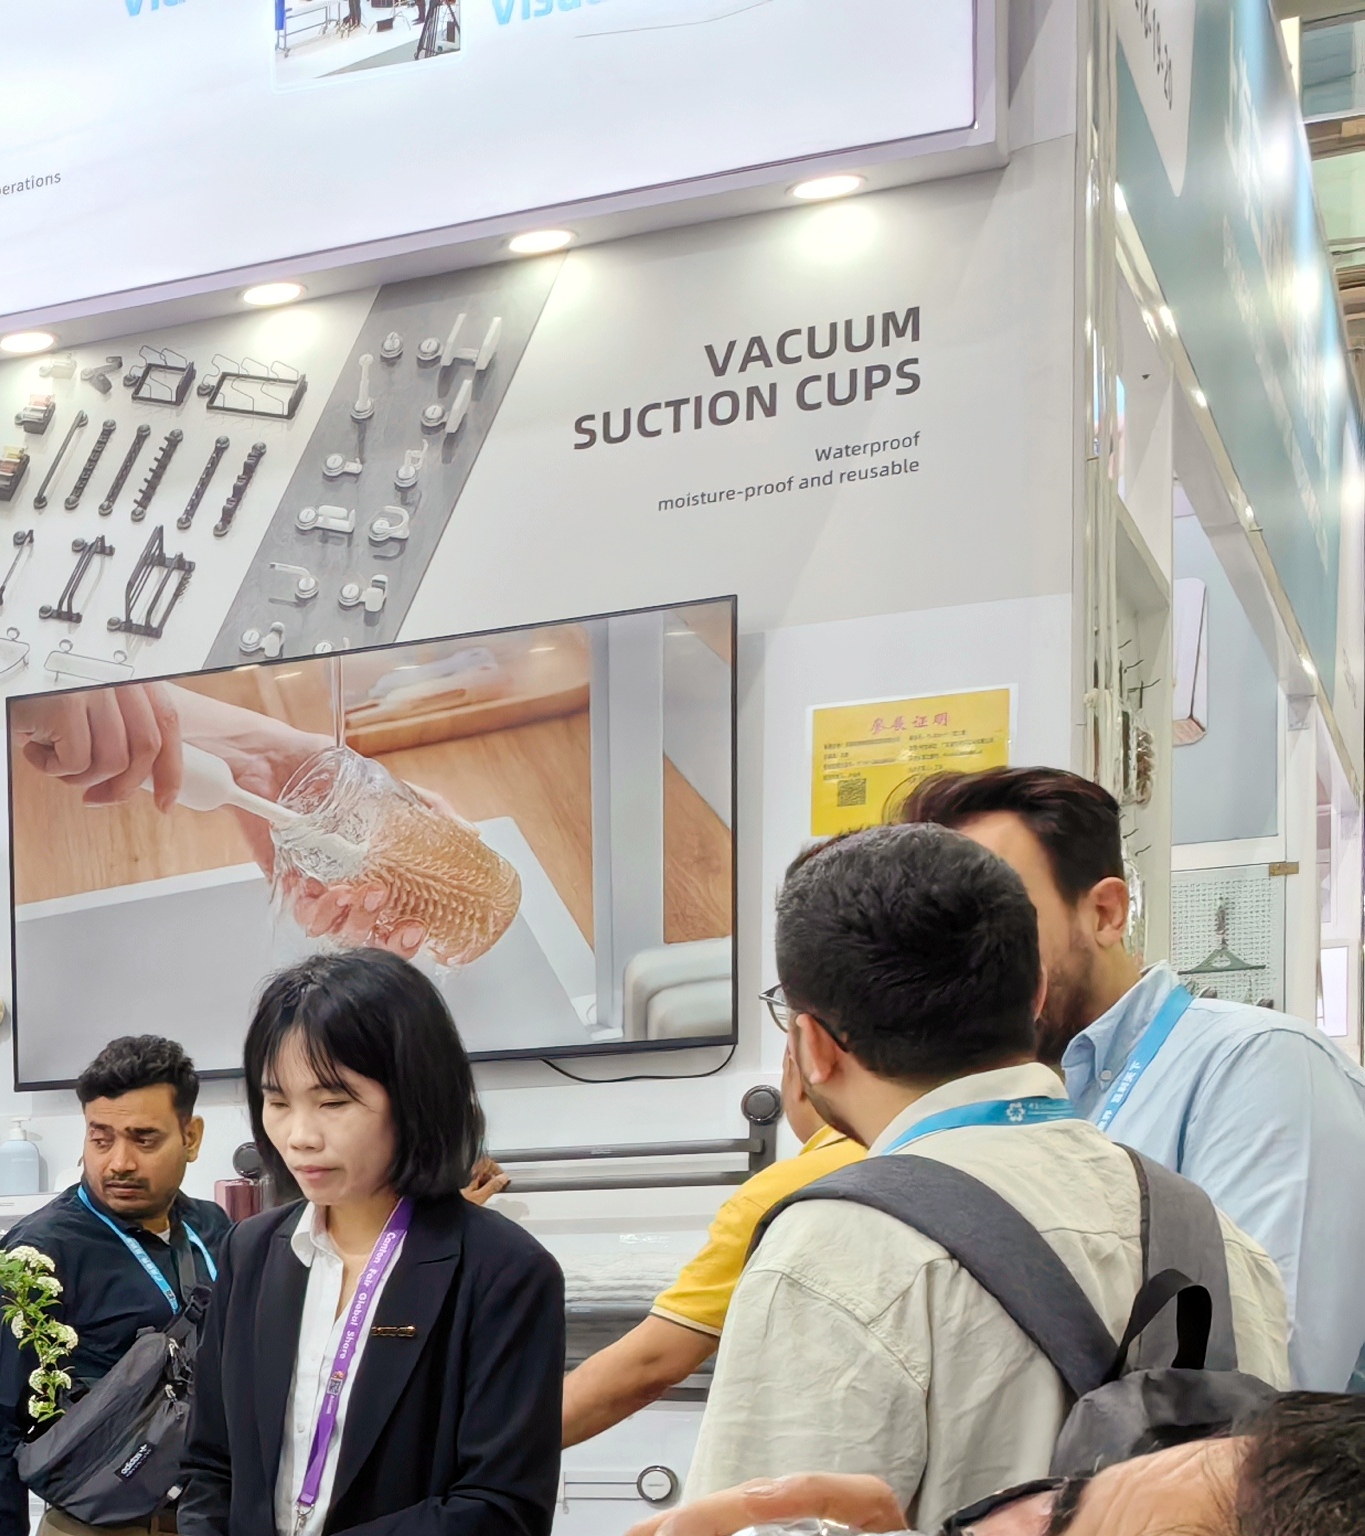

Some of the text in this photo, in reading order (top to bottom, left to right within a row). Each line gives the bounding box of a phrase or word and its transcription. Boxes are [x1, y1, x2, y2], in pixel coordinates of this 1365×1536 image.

[704, 305, 922, 378] VACUUM
[573, 356, 922, 451] SUCTION CUPS
[657, 456, 920, 513] moisture-proof and reusable
[815, 431, 921, 465] Waterproof
[340, 1231, 397, 1360] Canton Fair Global Share
